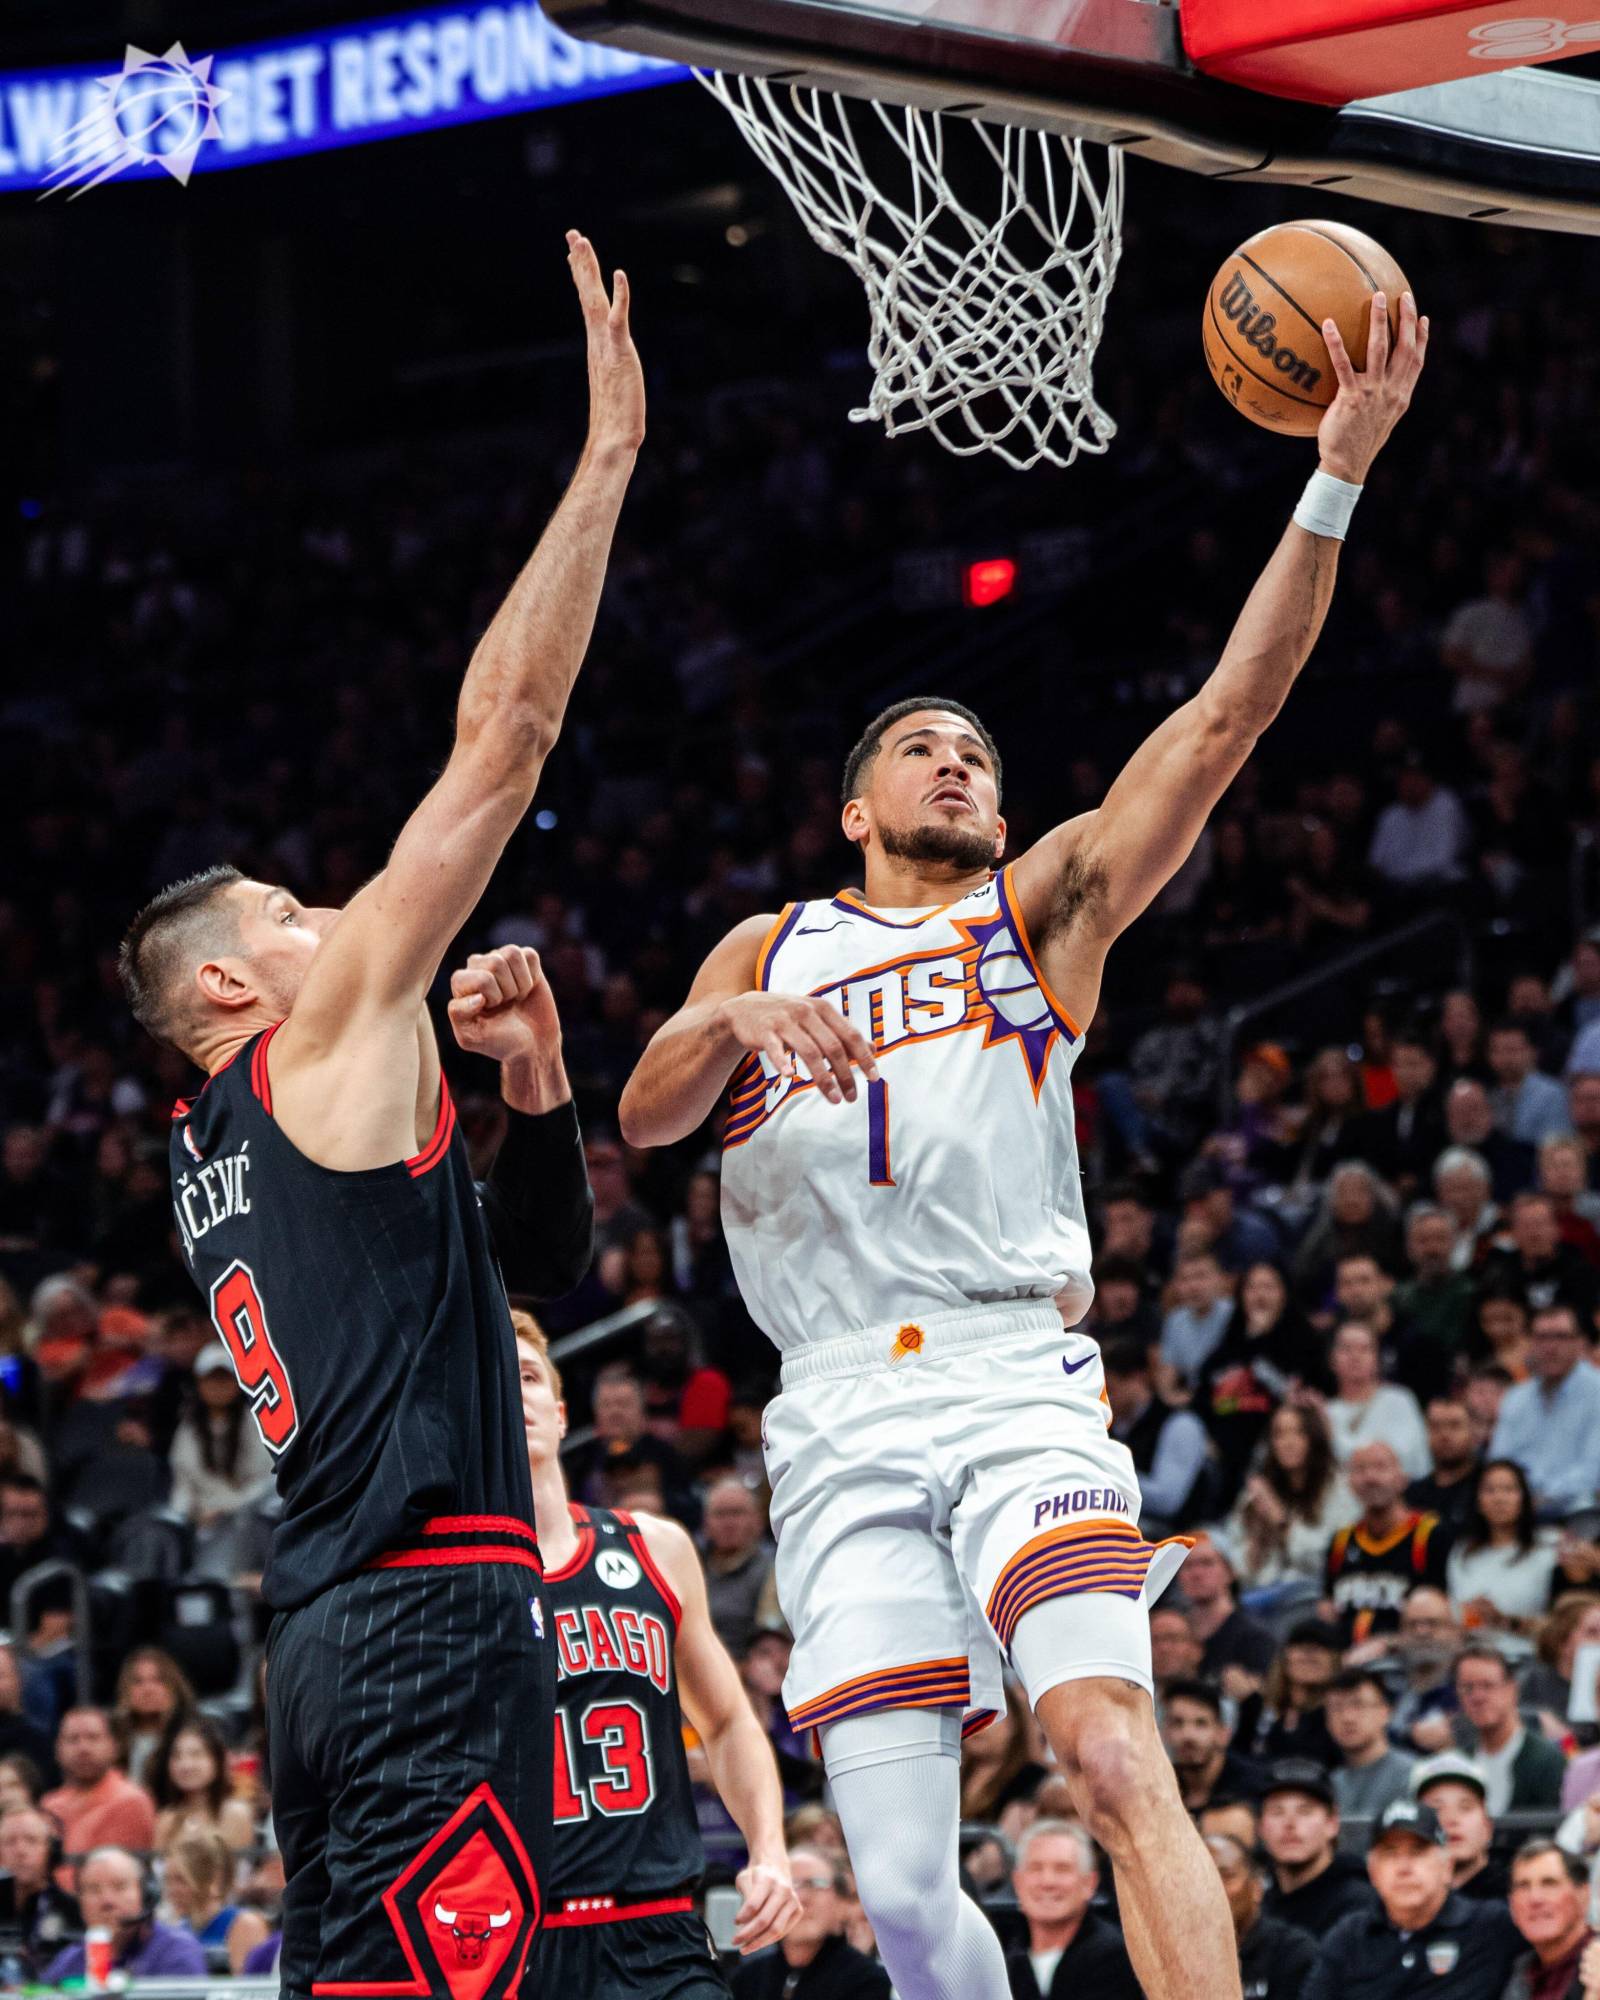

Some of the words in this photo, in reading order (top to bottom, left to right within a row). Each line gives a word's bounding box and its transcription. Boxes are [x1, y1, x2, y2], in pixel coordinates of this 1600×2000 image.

[219, 46, 323, 152] BET
[1219, 269, 1322, 393] Wilson
[867, 1078, 896, 1186] 1
[210, 1258, 299, 1455] 9
[554, 1607, 671, 1695] CAGO
